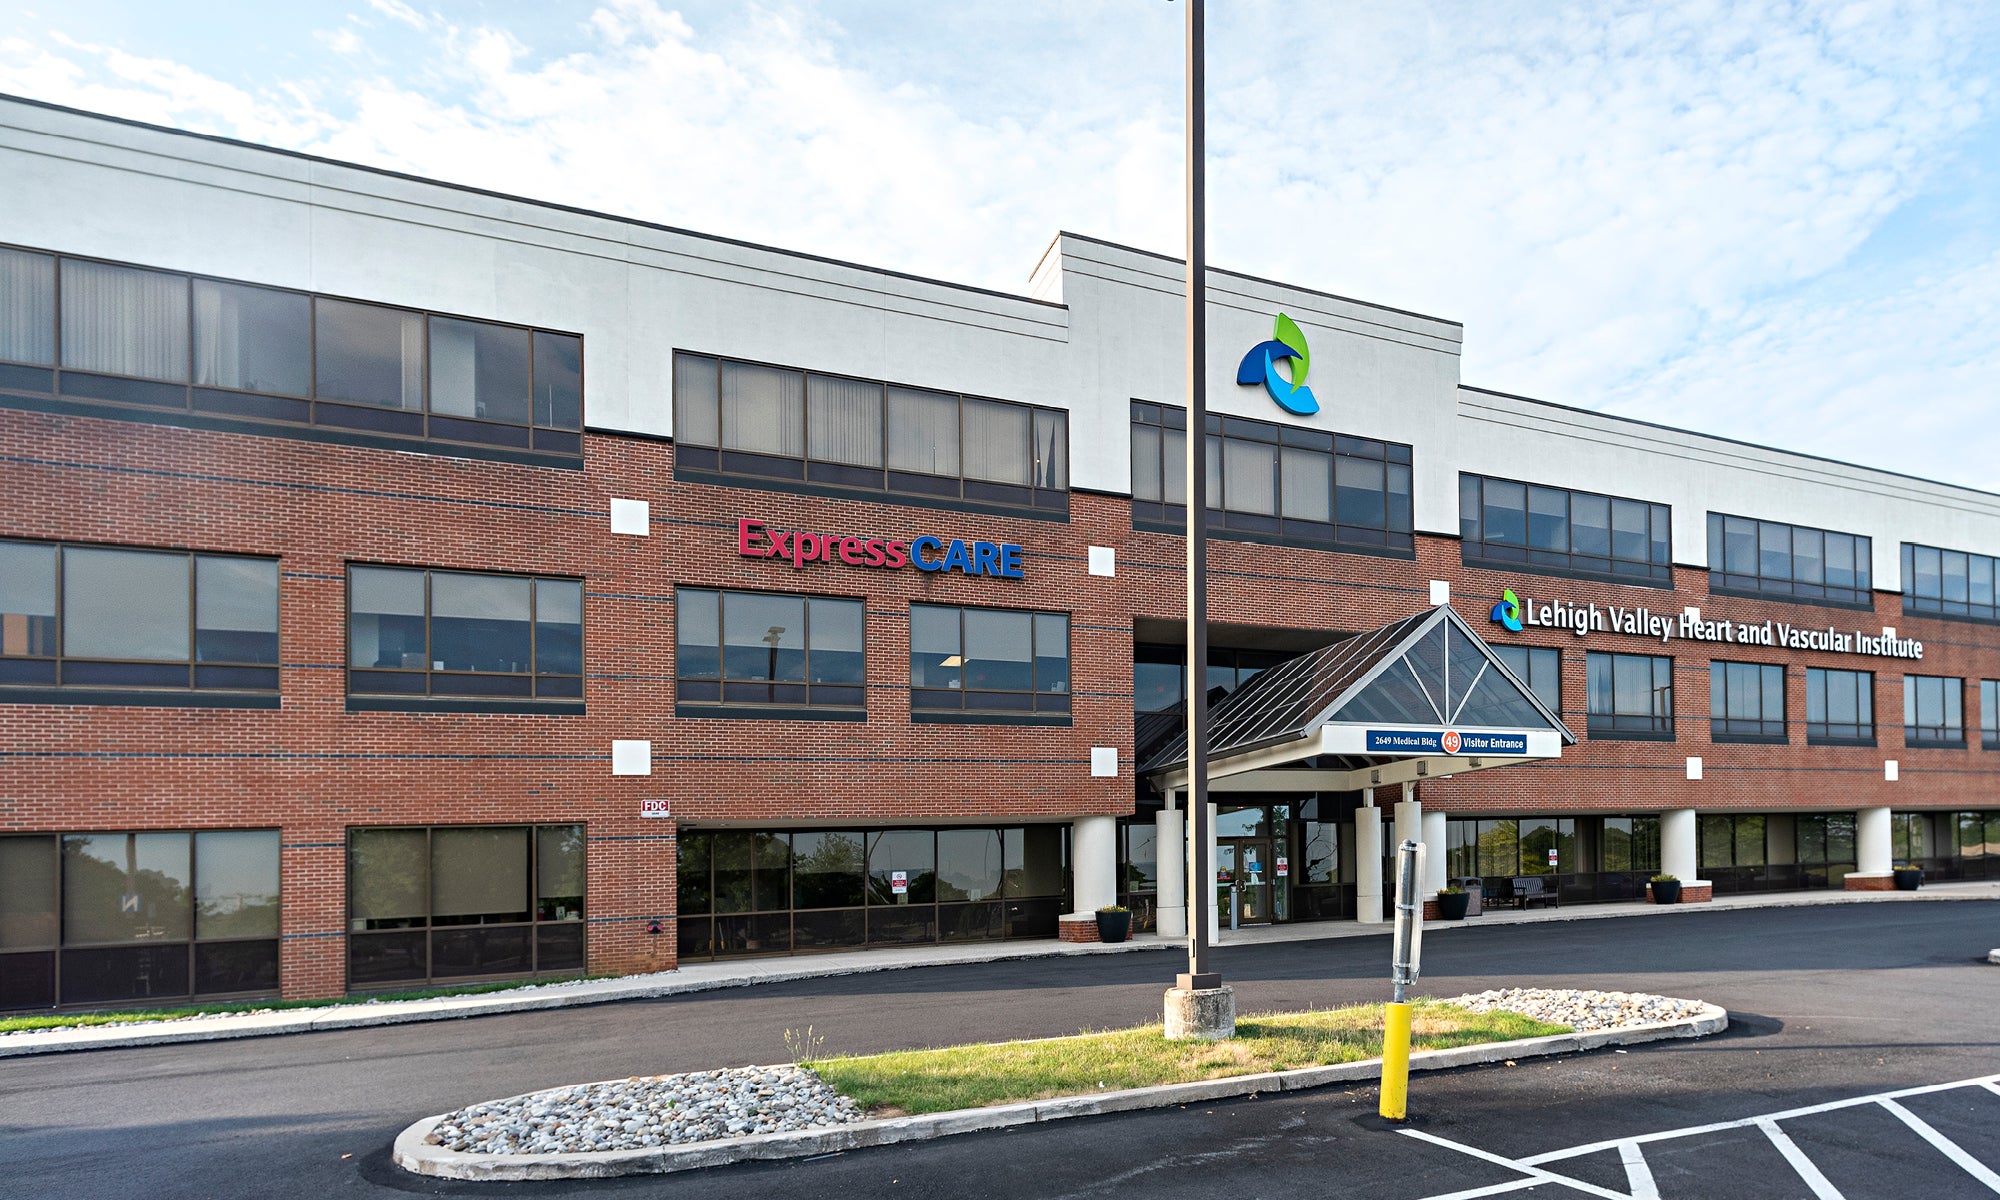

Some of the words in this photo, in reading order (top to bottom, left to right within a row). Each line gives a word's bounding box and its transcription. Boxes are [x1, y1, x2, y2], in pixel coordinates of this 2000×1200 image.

[738, 518, 1024, 578] ExpressCARE
[1526, 599, 1603, 636] Lehigh
[1608, 605, 1673, 642] Valley
[1679, 610, 1732, 642] Heart
[1737, 620, 1772, 645] and
[1776, 623, 1852, 653] Vascular
[1855, 630, 1923, 659] Institute
[1375, 736, 1392, 745] 2649
[1393, 737, 1420, 746] Medical
[1421, 737, 1437, 748] Bldg
[1445, 736, 1459, 748] 49
[1463, 738, 1489, 748] Visitor
[1490, 738, 1524, 749] Entrance
[644, 801, 667, 811] FDC
